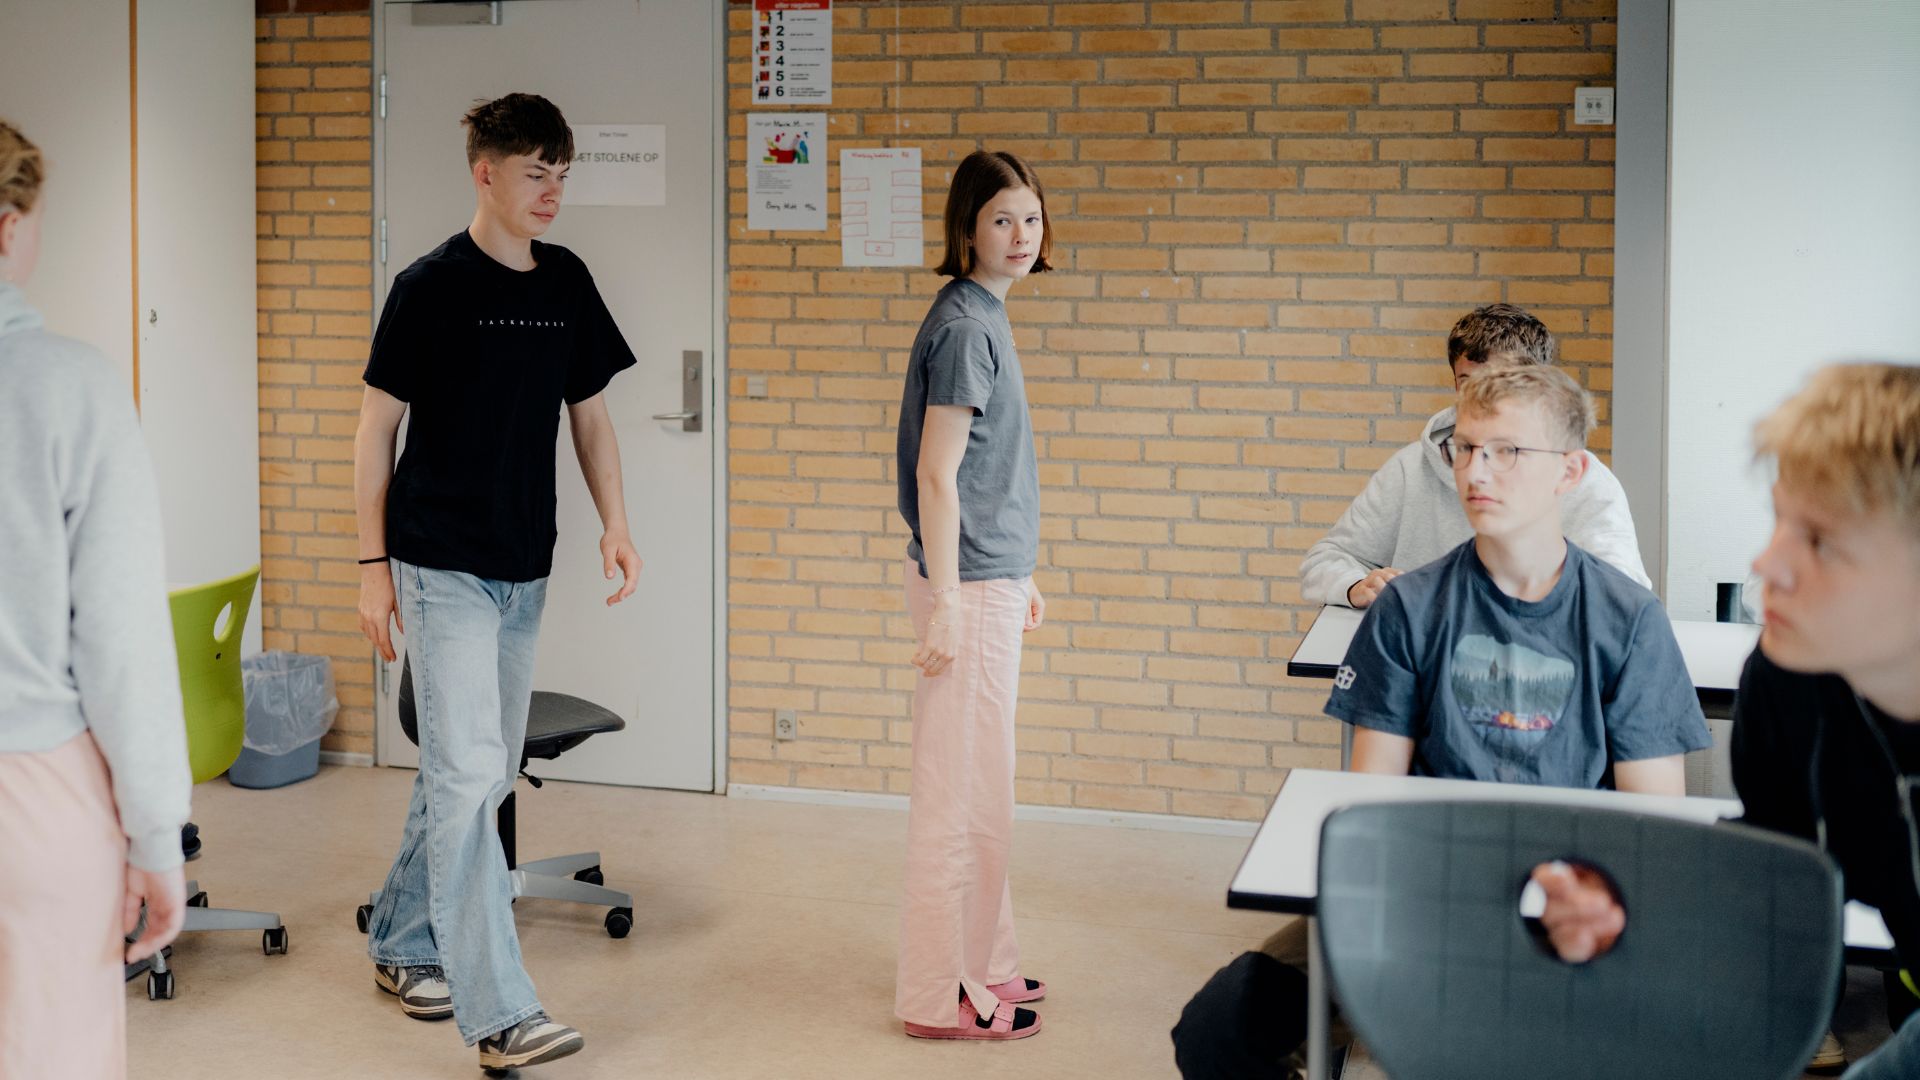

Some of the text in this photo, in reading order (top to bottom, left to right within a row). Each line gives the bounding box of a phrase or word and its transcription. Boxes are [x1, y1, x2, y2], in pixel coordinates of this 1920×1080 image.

[776, 10, 783, 21] 1
[776, 26, 784, 36] 2
[776, 41, 784, 51] 3
[776, 56, 784, 66] 4
[776, 71, 784, 81] 5
[776, 86, 784, 97] 6
[594, 152, 641, 163] STOLENE
[643, 152, 659, 163] OP
